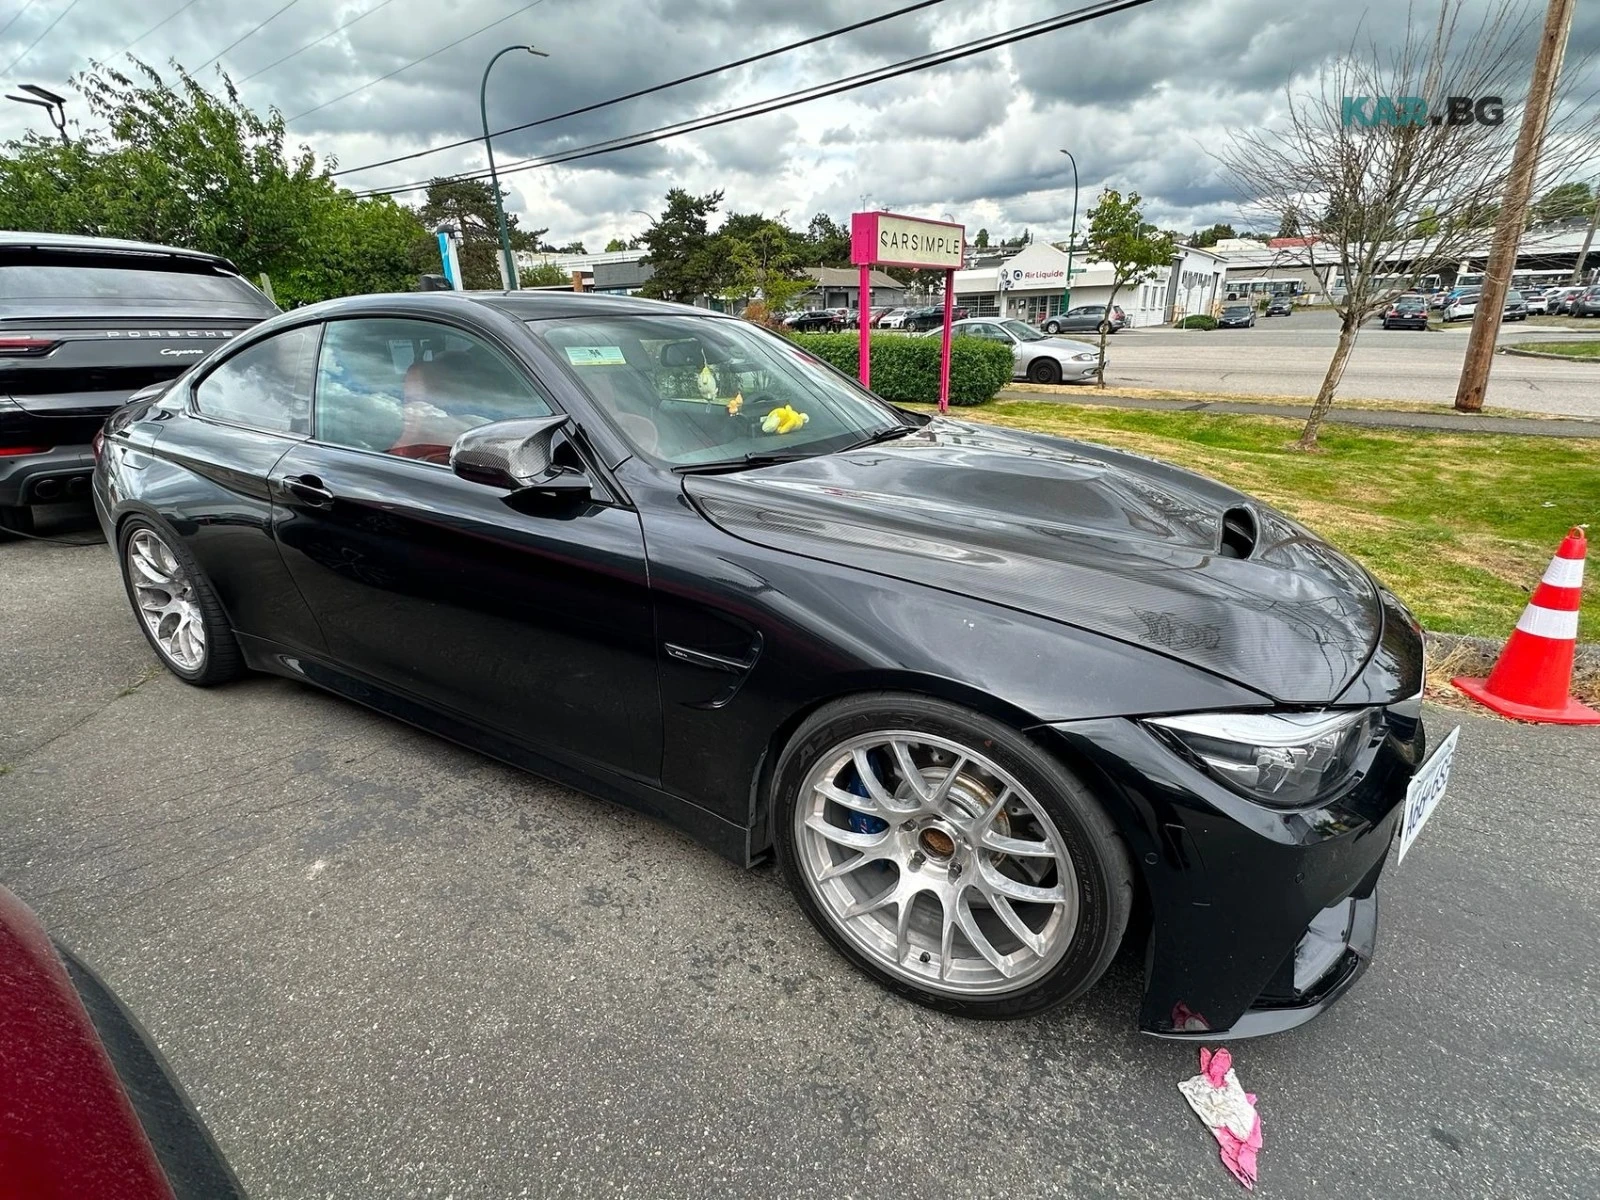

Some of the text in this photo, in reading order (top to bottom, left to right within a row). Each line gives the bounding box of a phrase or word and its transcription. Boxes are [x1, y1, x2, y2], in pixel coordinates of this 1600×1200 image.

[880, 230, 960, 255] CARSIMPLE
[1024, 271, 1035, 279] Air
[1036, 270, 1064, 279] Liquide
[106, 330, 235, 338] PORSCHE
[160, 348, 204, 357] Cayenne
